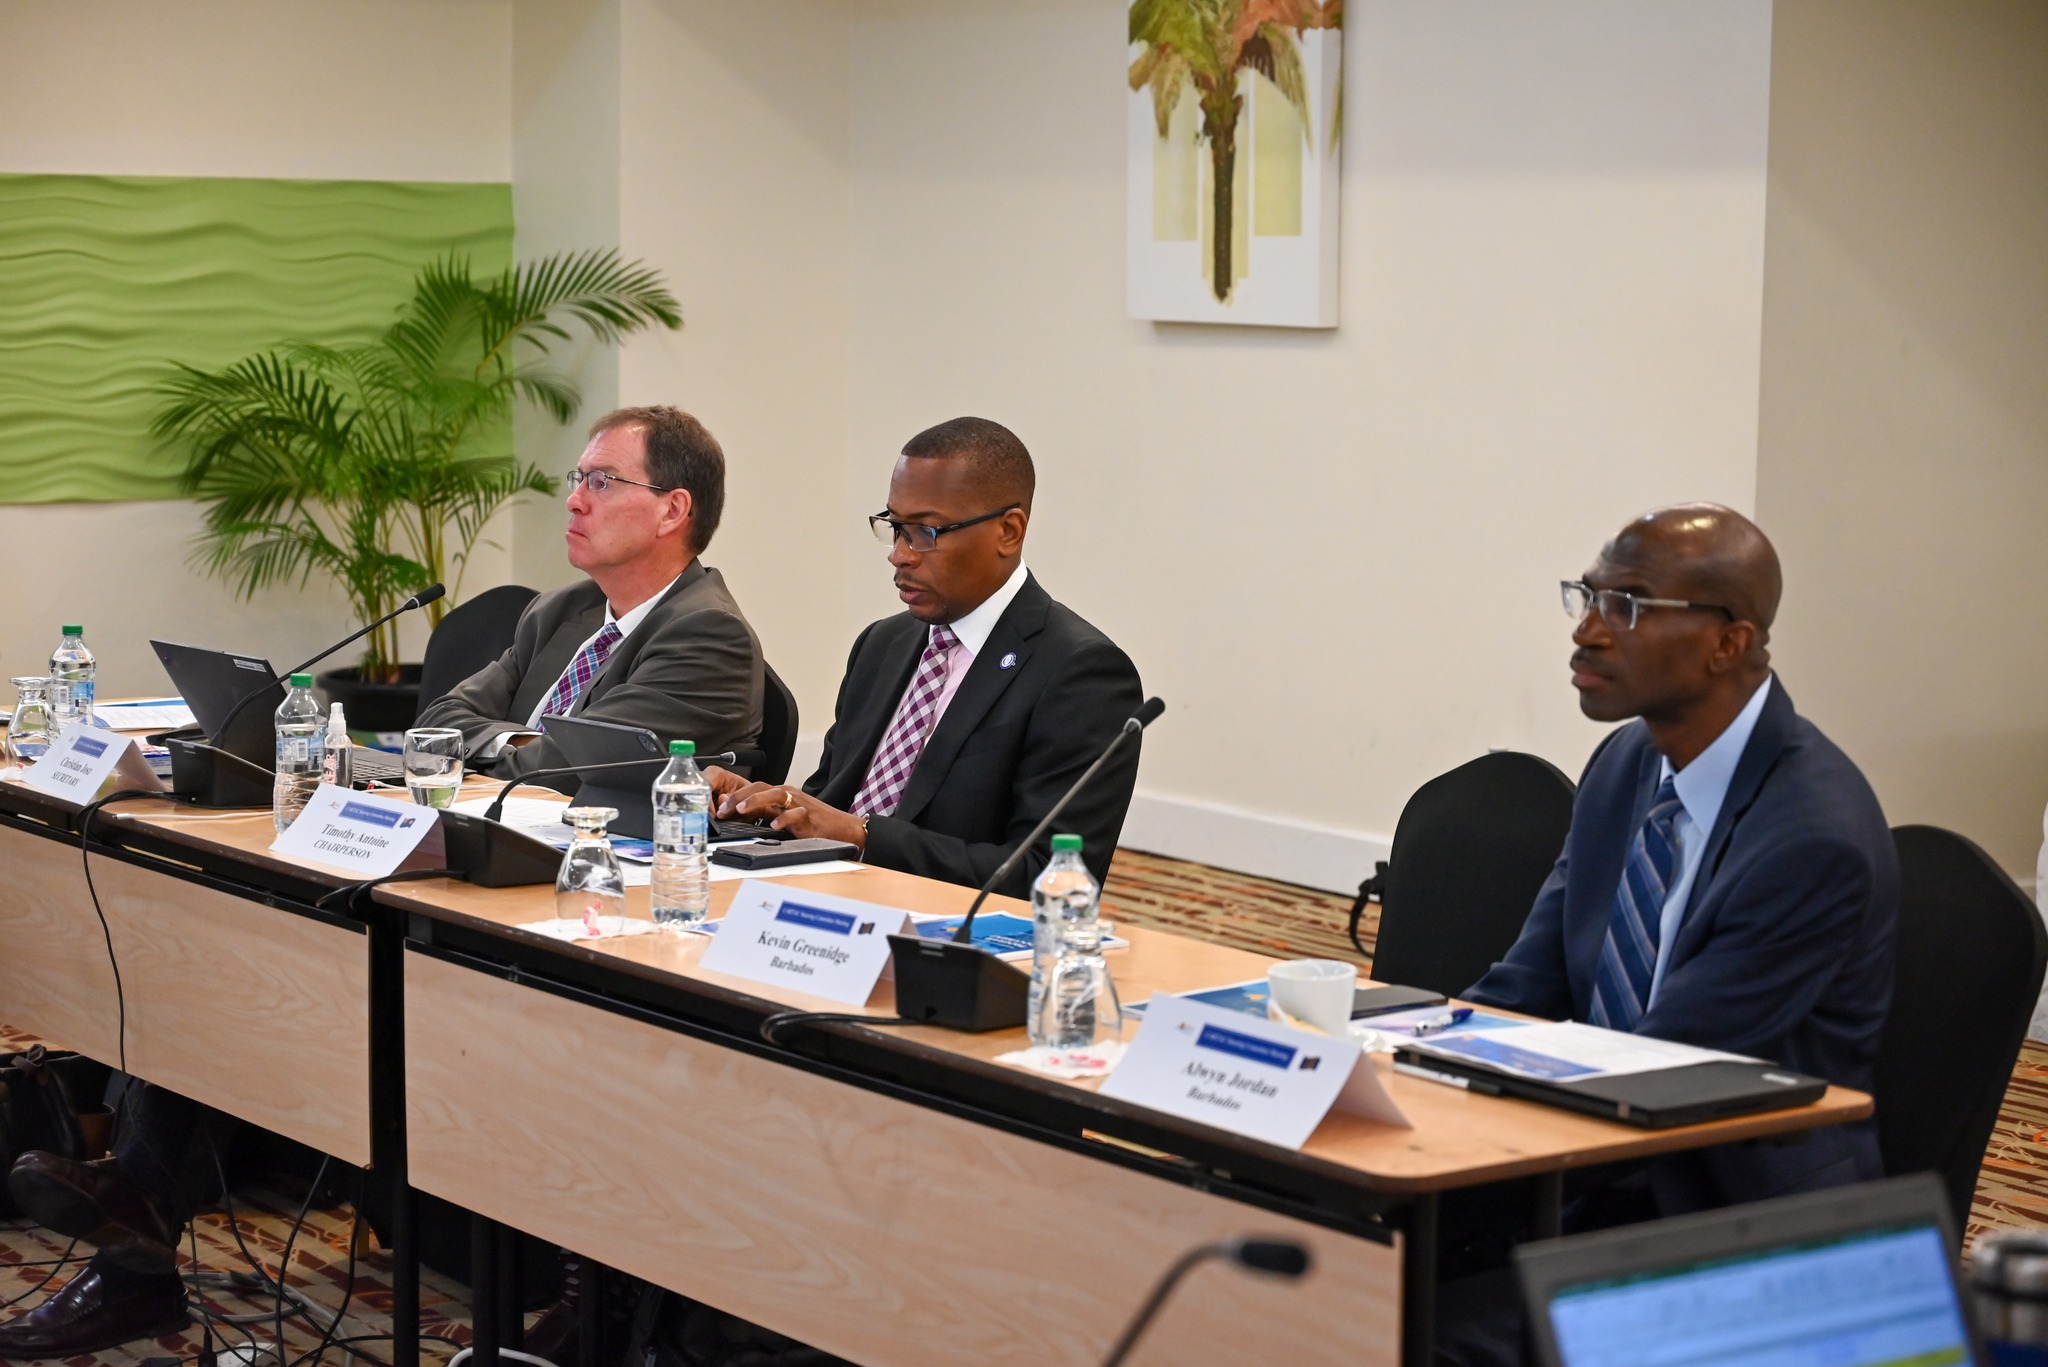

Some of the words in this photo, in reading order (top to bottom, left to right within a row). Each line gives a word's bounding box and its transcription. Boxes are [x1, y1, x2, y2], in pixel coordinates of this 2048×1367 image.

[60, 757, 82, 772] Christian
[80, 763, 93, 775] Jost
[51, 771, 80, 786] SECRETARY
[322, 824, 354, 842] Timothy
[356, 833, 390, 849] Antoine
[314, 840, 373, 859] CHAIRPERSON
[757, 930, 790, 950] Kevin
[793, 938, 851, 965] Greenidge
[769, 956, 815, 976] Barbados
[1185, 1062, 1227, 1087] Alwyn
[1228, 1072, 1277, 1098] Jordan
[1188, 1086, 1240, 1110] Barbados
